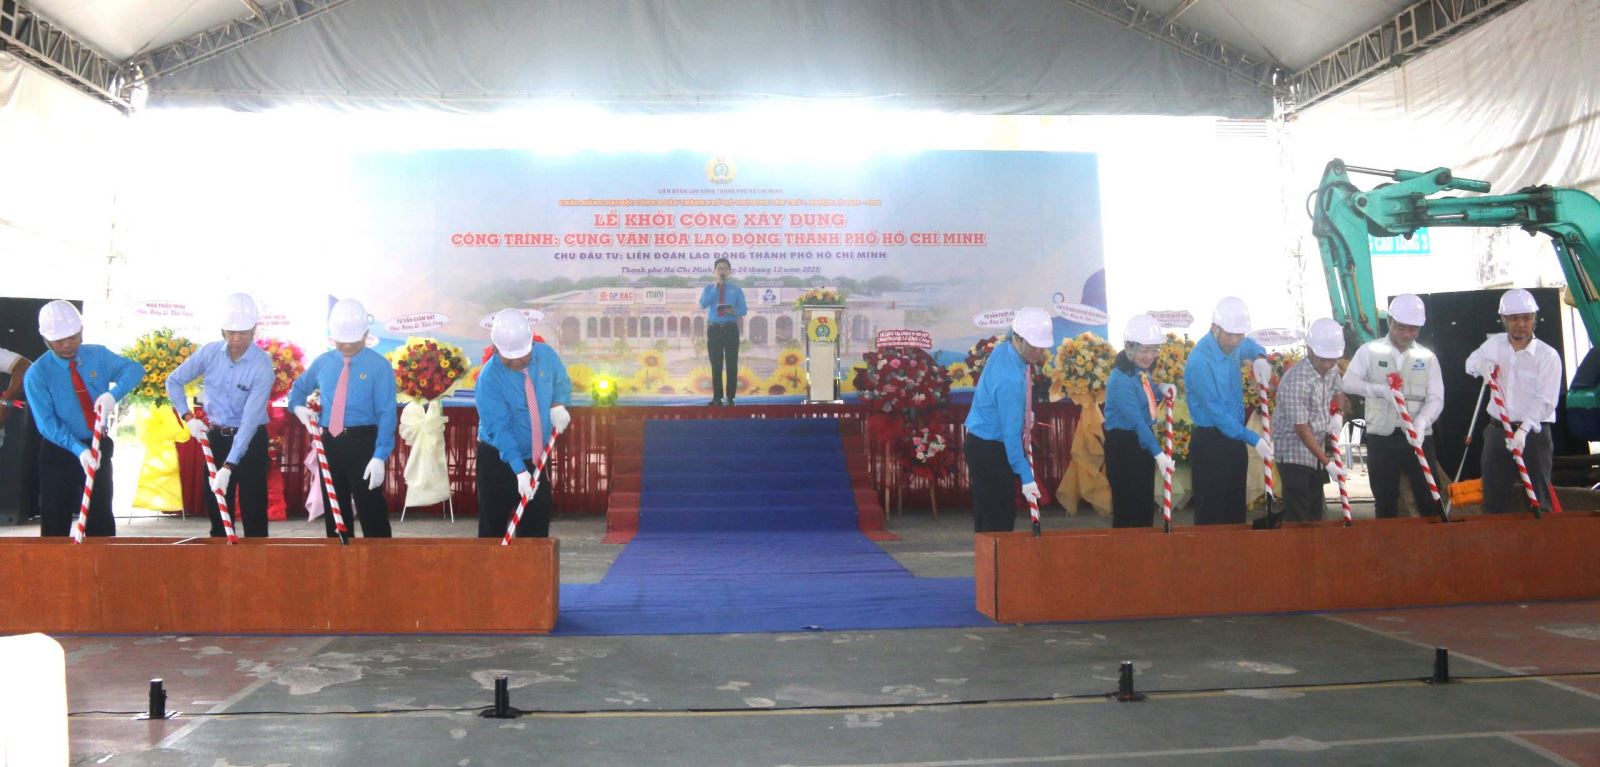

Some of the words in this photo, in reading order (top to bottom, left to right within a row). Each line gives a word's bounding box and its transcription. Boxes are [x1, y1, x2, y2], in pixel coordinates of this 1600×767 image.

[594, 210, 618, 226] LỄ
[625, 211, 673, 226] KHỞI
[680, 211, 737, 226] CÔNG
[744, 211, 784, 226] XÂY
[790, 211, 845, 229] DỰNG
[452, 232, 499, 245] CÔNG
[504, 231, 559, 246] TRÌNH:
[564, 233, 611, 245] CUNG
[616, 232, 649, 245] VĂN
[694, 233, 727, 244] LAO
[732, 232, 779, 247] ĐỘNG
[784, 231, 839, 244] THÀNH
[845, 230, 877, 244] PHỐ
[882, 231, 905, 244] HỒ
[910, 231, 938, 244] CHÍ
[943, 233, 984, 244] MINH
[554, 250, 576, 259] CHỦ
[580, 250, 601, 259] ĐẦU
[606, 250, 623, 260] TƯ:
[626, 250, 650, 259] LIÊN
[654, 250, 686, 259] ĐOÀN
[689, 251, 710, 259] LAO
[750, 250, 786, 259] THÀNH
[790, 250, 813, 259] PHỐ
[817, 250, 832, 259] HỒ
[836, 250, 853, 259] CHÍ
[856, 251, 886, 259] MINH
